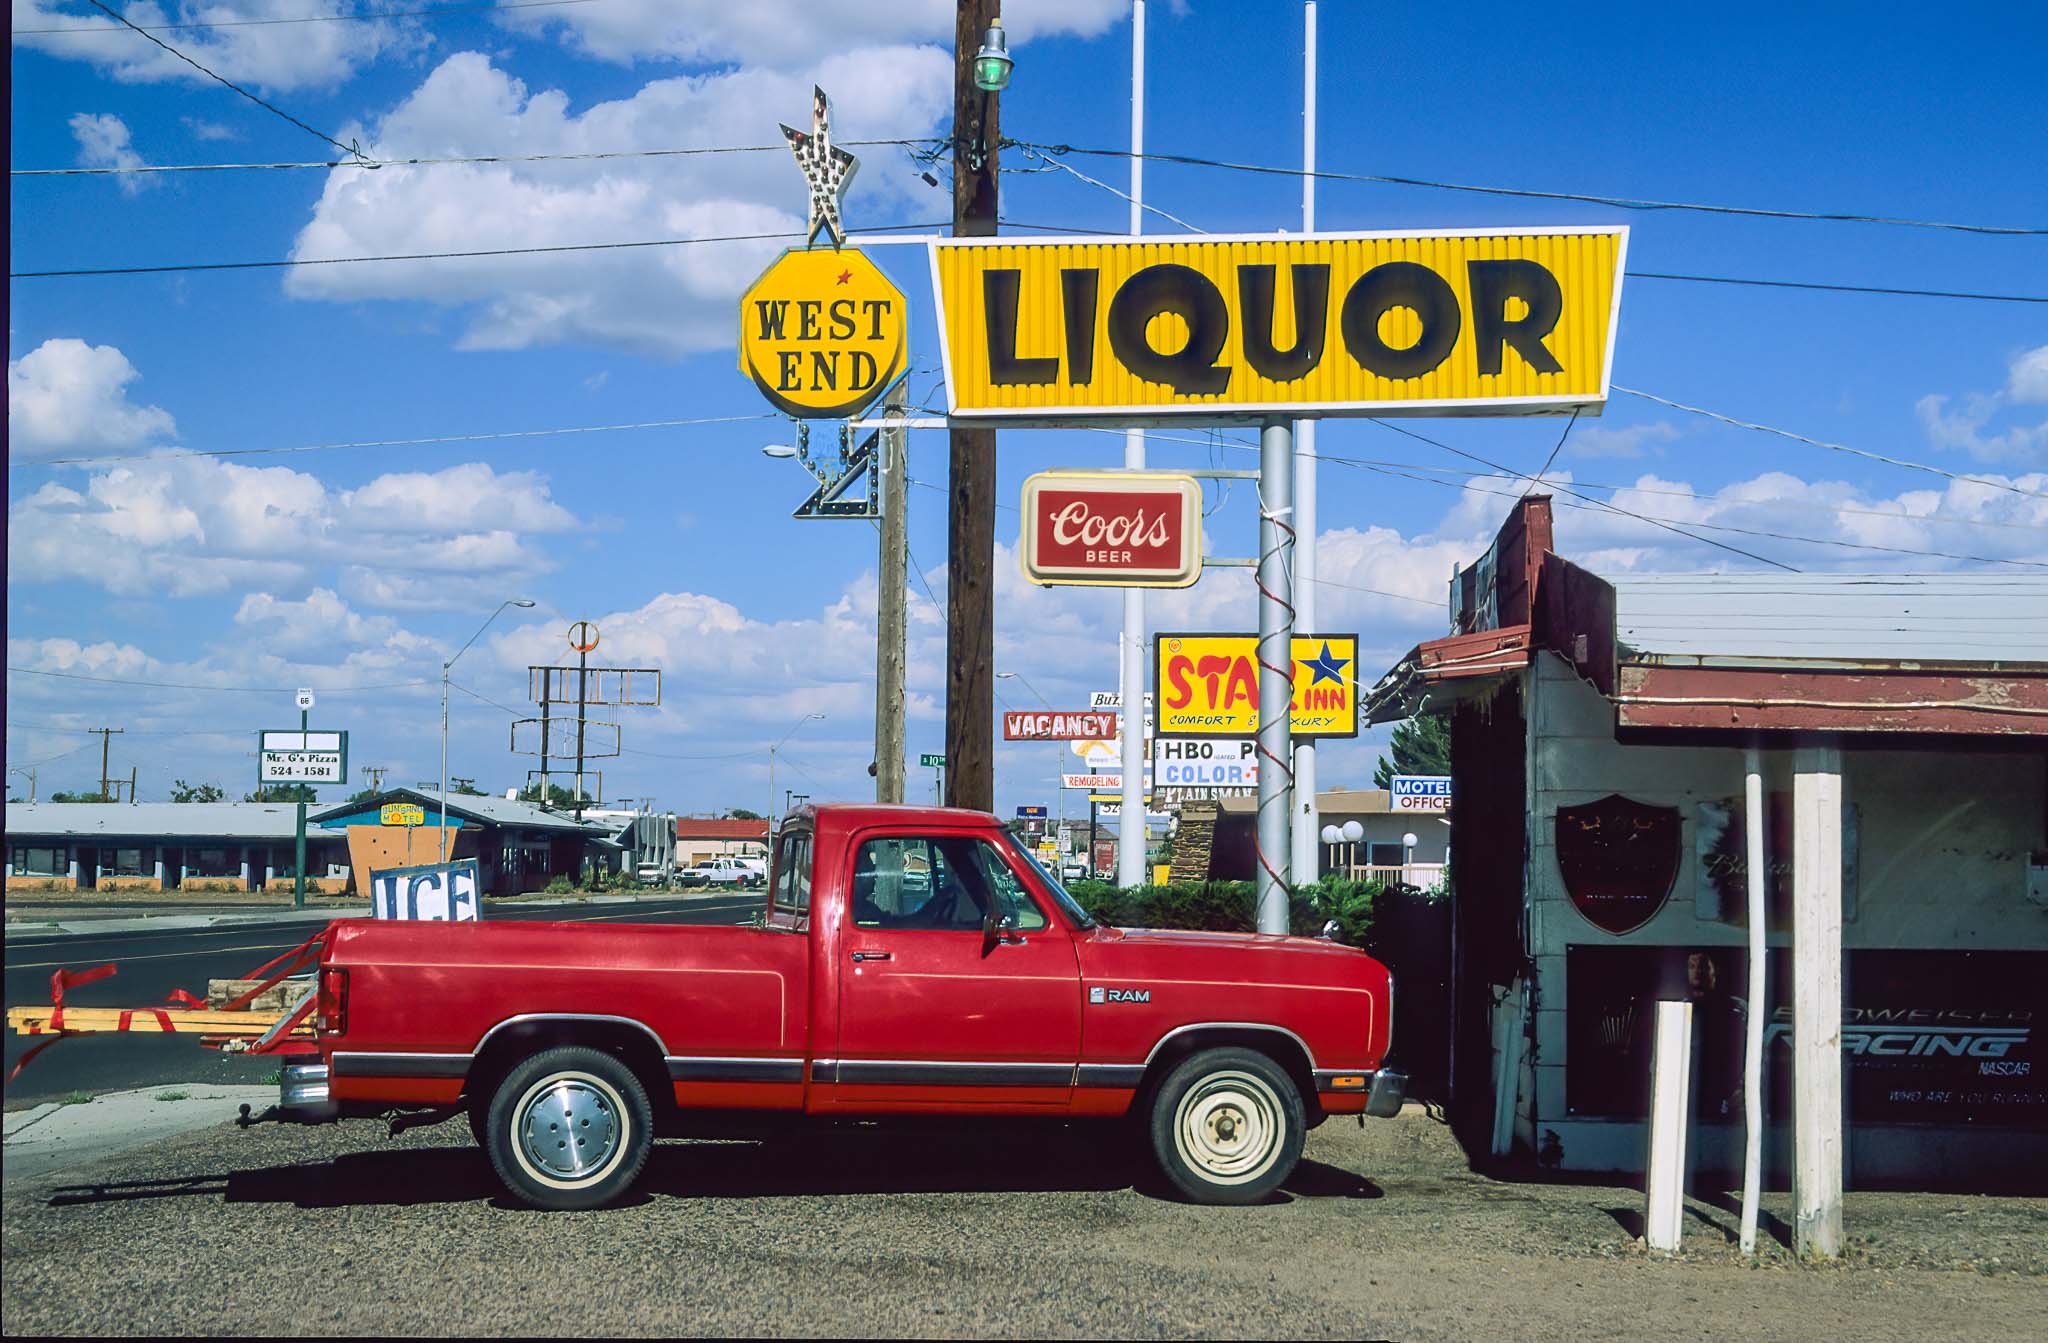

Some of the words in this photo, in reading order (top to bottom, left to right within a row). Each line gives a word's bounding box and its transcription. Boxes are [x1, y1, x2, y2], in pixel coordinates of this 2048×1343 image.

[755, 300, 891, 340] WEST
[983, 259, 1564, 396] LIQUOR
[777, 351, 877, 391] END
[1050, 501, 1170, 547] Coors
[1086, 551, 1131, 562] BEER
[1166, 655, 1298, 711] STA
[1304, 688, 1346, 711] INN
[1007, 715, 1112, 737] VACANCY
[1169, 715, 1237, 726] COMFORT
[1290, 717, 1336, 726] XURY
[266, 753, 284, 763] Mr.
[288, 753, 304, 763] G's
[309, 753, 337, 763] Pizza
[1165, 742, 1213, 760] HBO
[271, 766, 292, 776] 524
[304, 766, 330, 776] 1581
[1068, 775, 1120, 787] REMODELING
[1396, 780, 1452, 794] MOTEL
[1401, 796, 1452, 808] OFFICE
[384, 869, 473, 920] ICE
[1107, 989, 1150, 1002] RAM
[1978, 1061, 2031, 1076] NASCAR
